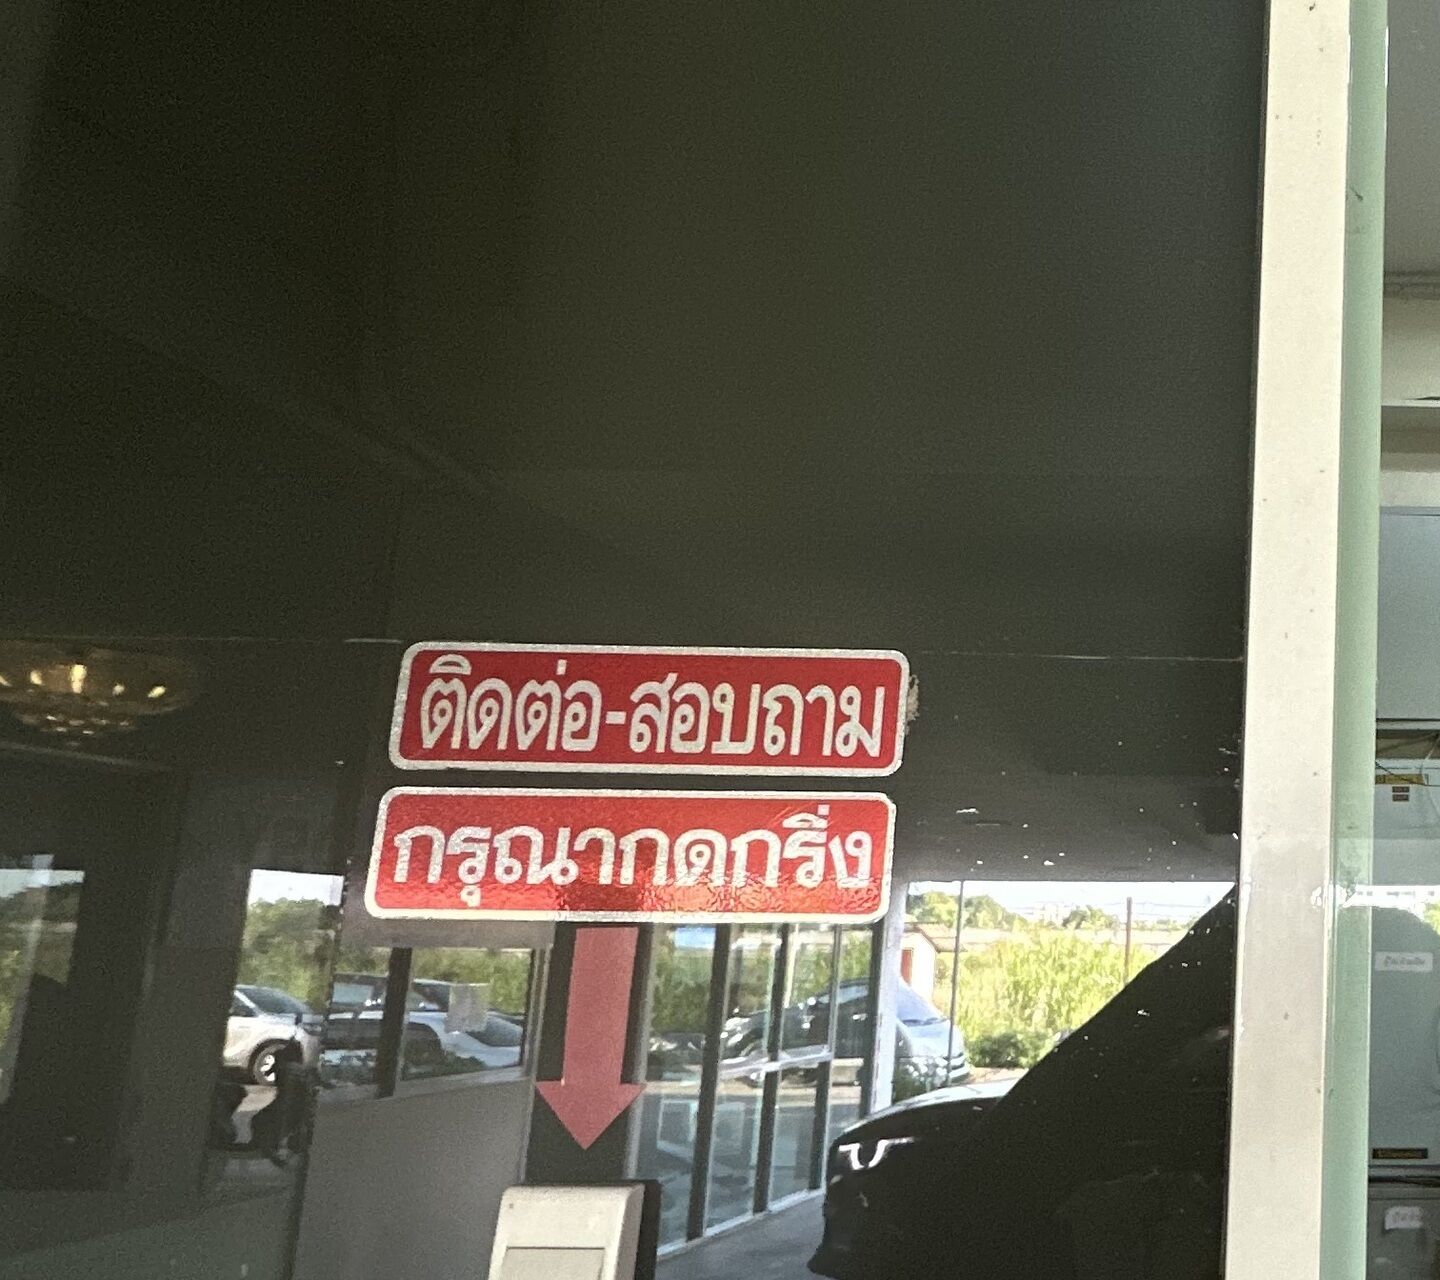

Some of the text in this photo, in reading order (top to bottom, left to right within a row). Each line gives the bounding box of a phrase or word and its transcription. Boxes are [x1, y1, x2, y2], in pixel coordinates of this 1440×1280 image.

[420, 653, 886, 758] ติดต่อ-สอบถาม
[392, 804, 874, 908] กรุณากดกริ่ง
